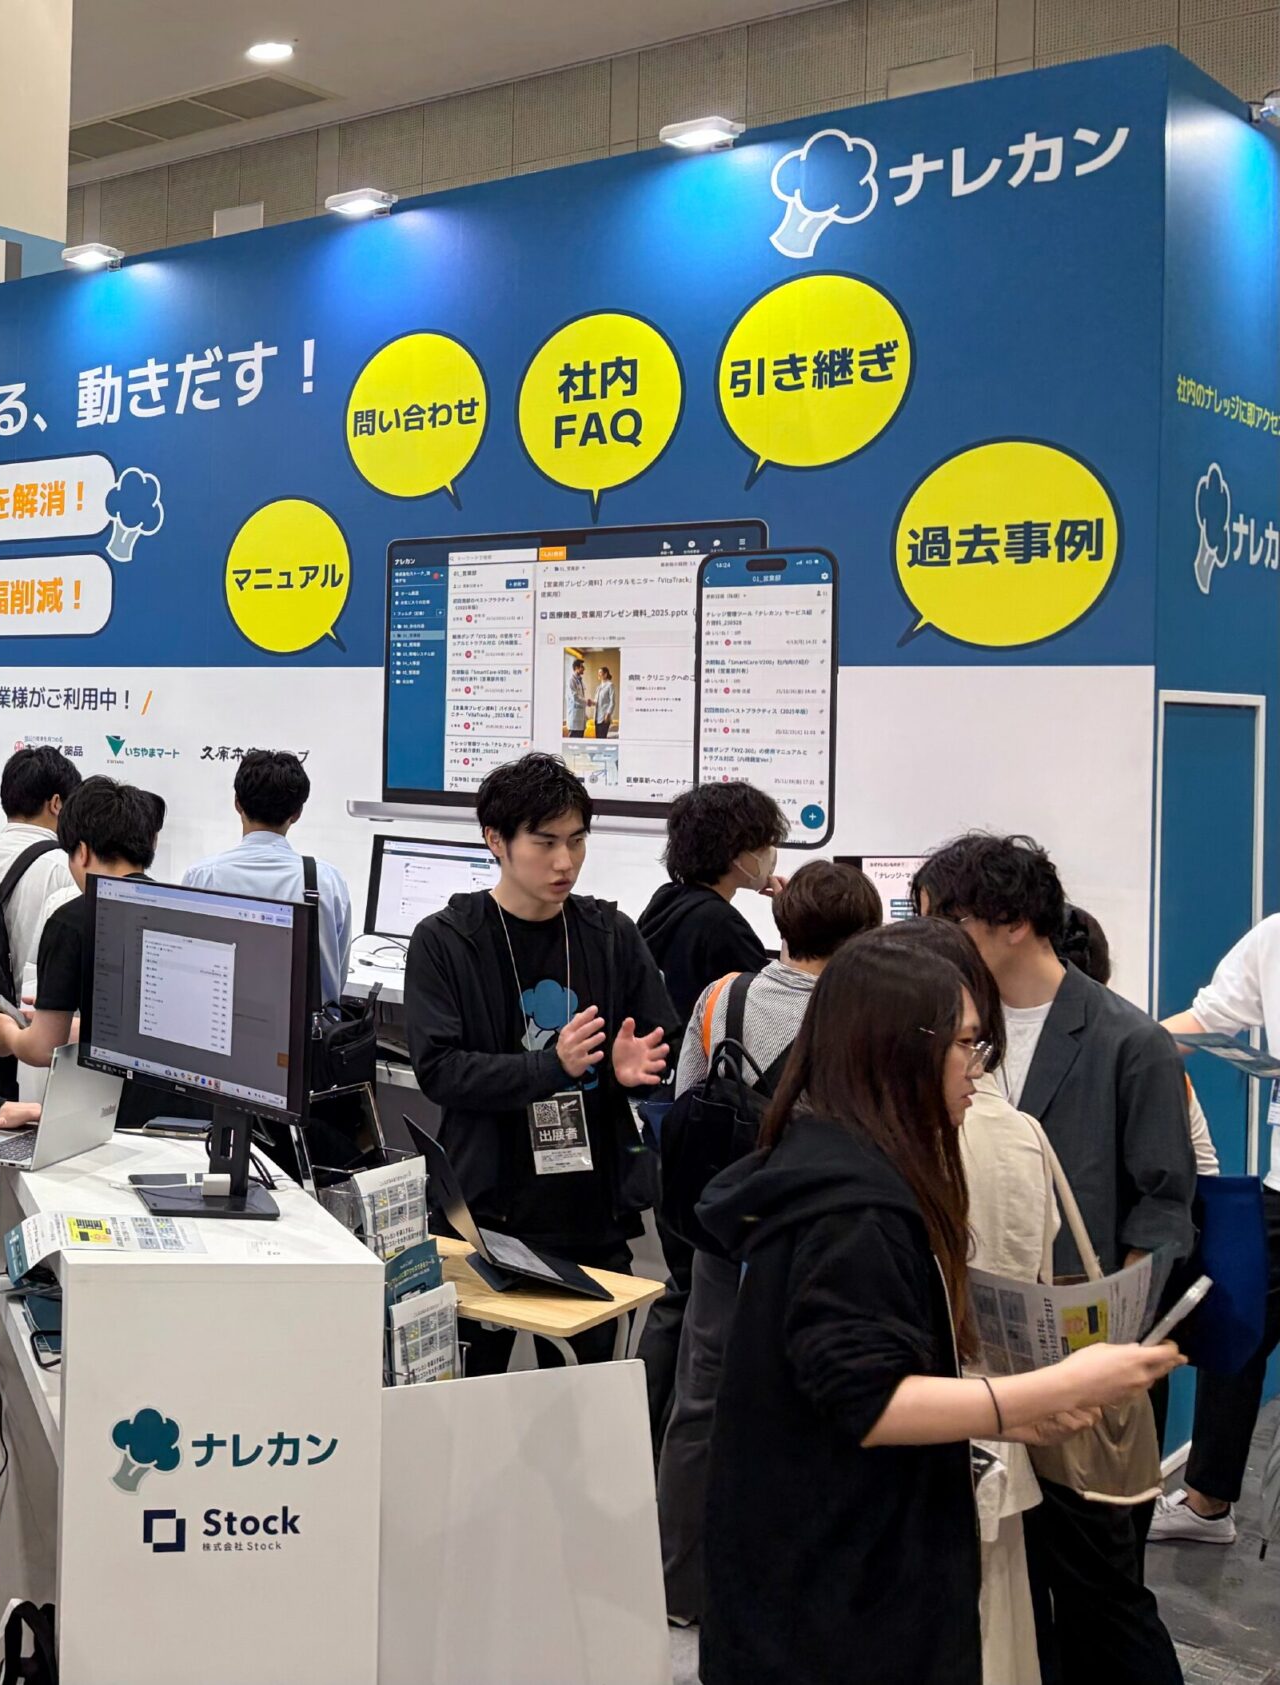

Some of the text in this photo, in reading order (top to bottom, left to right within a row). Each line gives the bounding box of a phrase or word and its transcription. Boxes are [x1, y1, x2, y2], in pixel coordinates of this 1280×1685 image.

[888, 126, 1131, 206] ナレカン
[557, 356, 638, 402] 社内
[729, 340, 900, 399] 引き継ぎ
[353, 395, 480, 438] 問い合わせ
[553, 410, 644, 450] FAQ
[906, 515, 1106, 571] 過去事例
[230, 560, 344, 594] マニュアル
[124, 746, 180, 759] いちやまマート
[538, 1127, 578, 1143] 出展者
[190, 1431, 339, 1469] ナレカン
[202, 1505, 301, 1537] Stock
[202, 1541, 282, 1552] 株式会社 Stock
